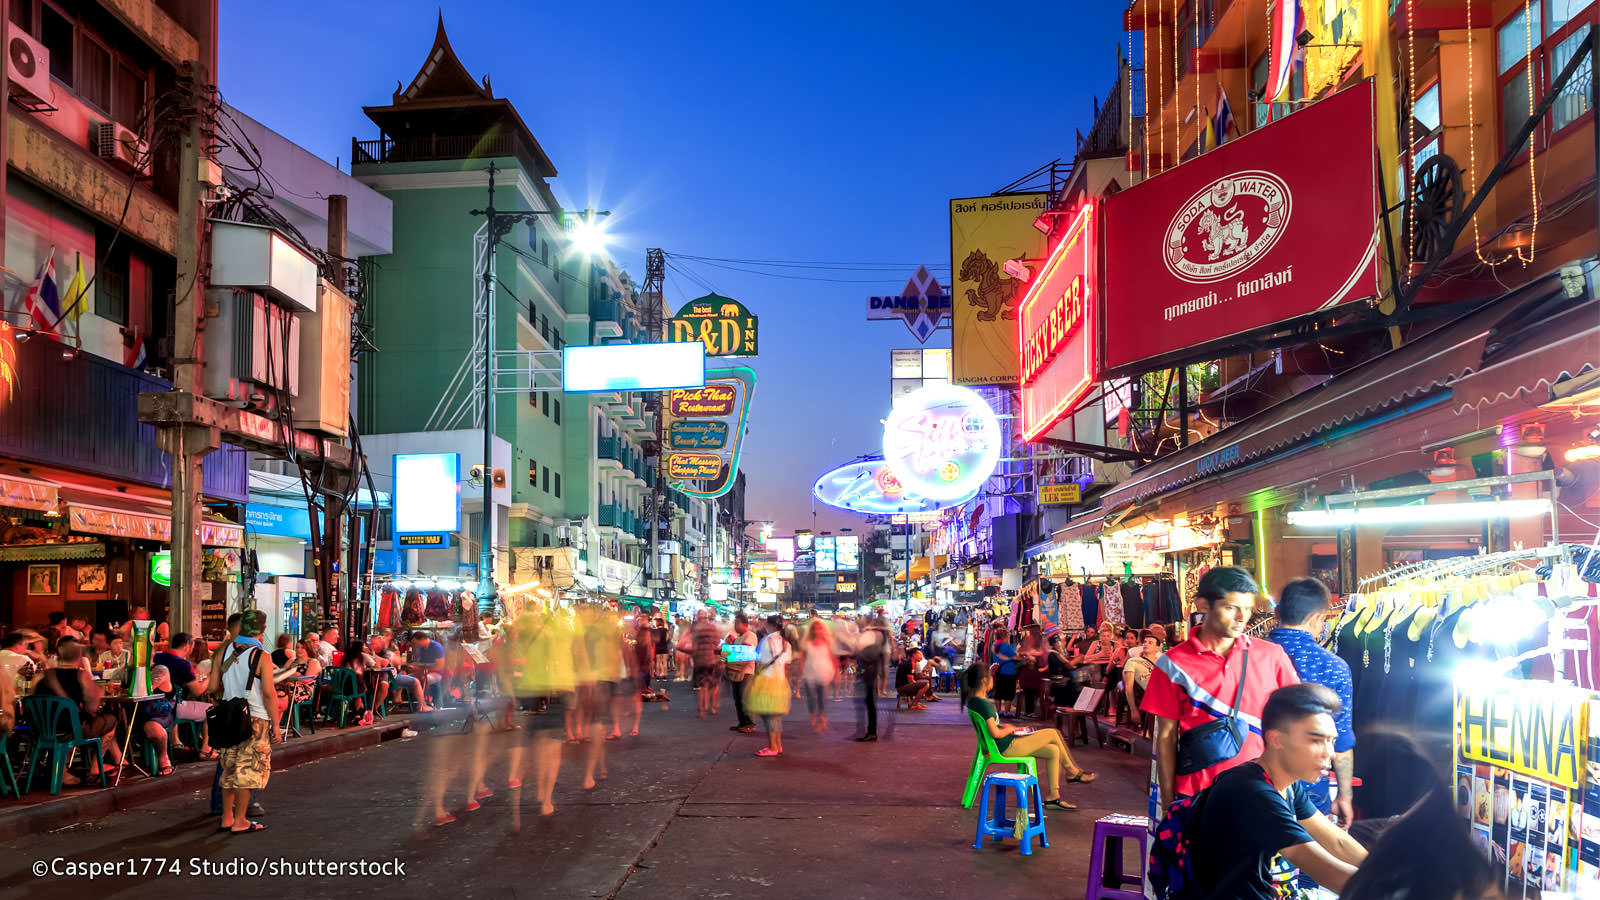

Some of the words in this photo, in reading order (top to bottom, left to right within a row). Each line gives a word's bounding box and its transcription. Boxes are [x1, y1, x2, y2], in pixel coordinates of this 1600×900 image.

[955, 201, 977, 213] สิงห์
[1177, 201, 1206, 232] SODA
[1239, 181, 1277, 202] WATER
[1237, 264, 1293, 298] โซดาสิงห์
[672, 318, 741, 355] D&D
[744, 318, 755, 352] INN
[1020, 317, 1049, 386] LUCKY
[1049, 275, 1081, 354] BEER
[673, 388, 733, 401] Pick-Thai
[678, 401, 726, 412] Restaurant
[672, 423, 707, 435] Swimming
[707, 422, 726, 433] Pool
[673, 435, 698, 447] Beauty
[700, 435, 722, 445] Salon
[672, 455, 689, 465] Thai
[689, 456, 719, 467] Massage
[1196, 451, 1219, 472] LUCKY
[1220, 444, 1240, 463] BEER
[672, 465, 698, 476] Shopping
[698, 465, 717, 475] Plaza
[1464, 690, 1578, 783] HENNA
